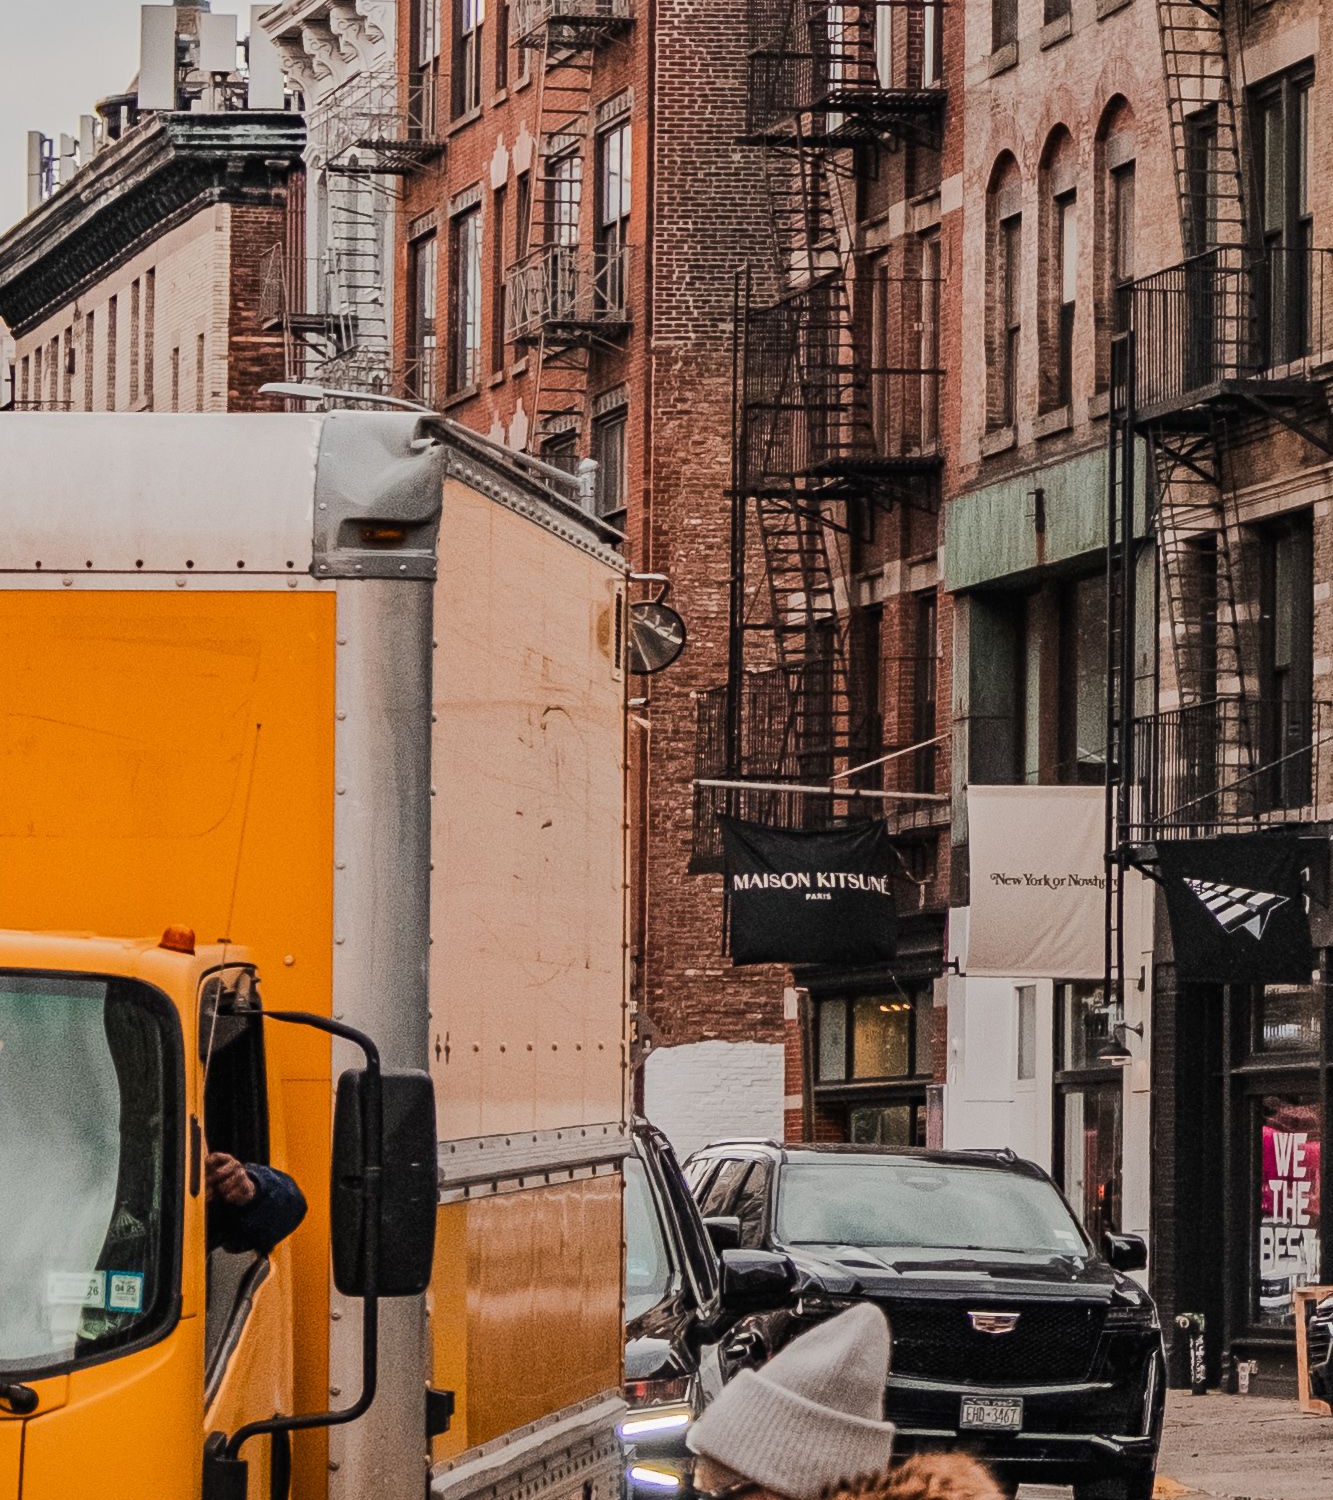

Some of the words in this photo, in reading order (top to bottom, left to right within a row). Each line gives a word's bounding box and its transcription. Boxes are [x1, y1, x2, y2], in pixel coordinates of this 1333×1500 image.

[733, 871, 811, 891] MAISON
[816, 872, 891, 896] KITSUNÉ
[990, 872, 1022, 886] New
[1023, 873, 1057, 890] York
[1053, 876, 1067, 887] or
[805, 892, 832, 901] PARIS
[1272, 1132, 1308, 1178] WE
[1268, 1179, 1312, 1226] THE
